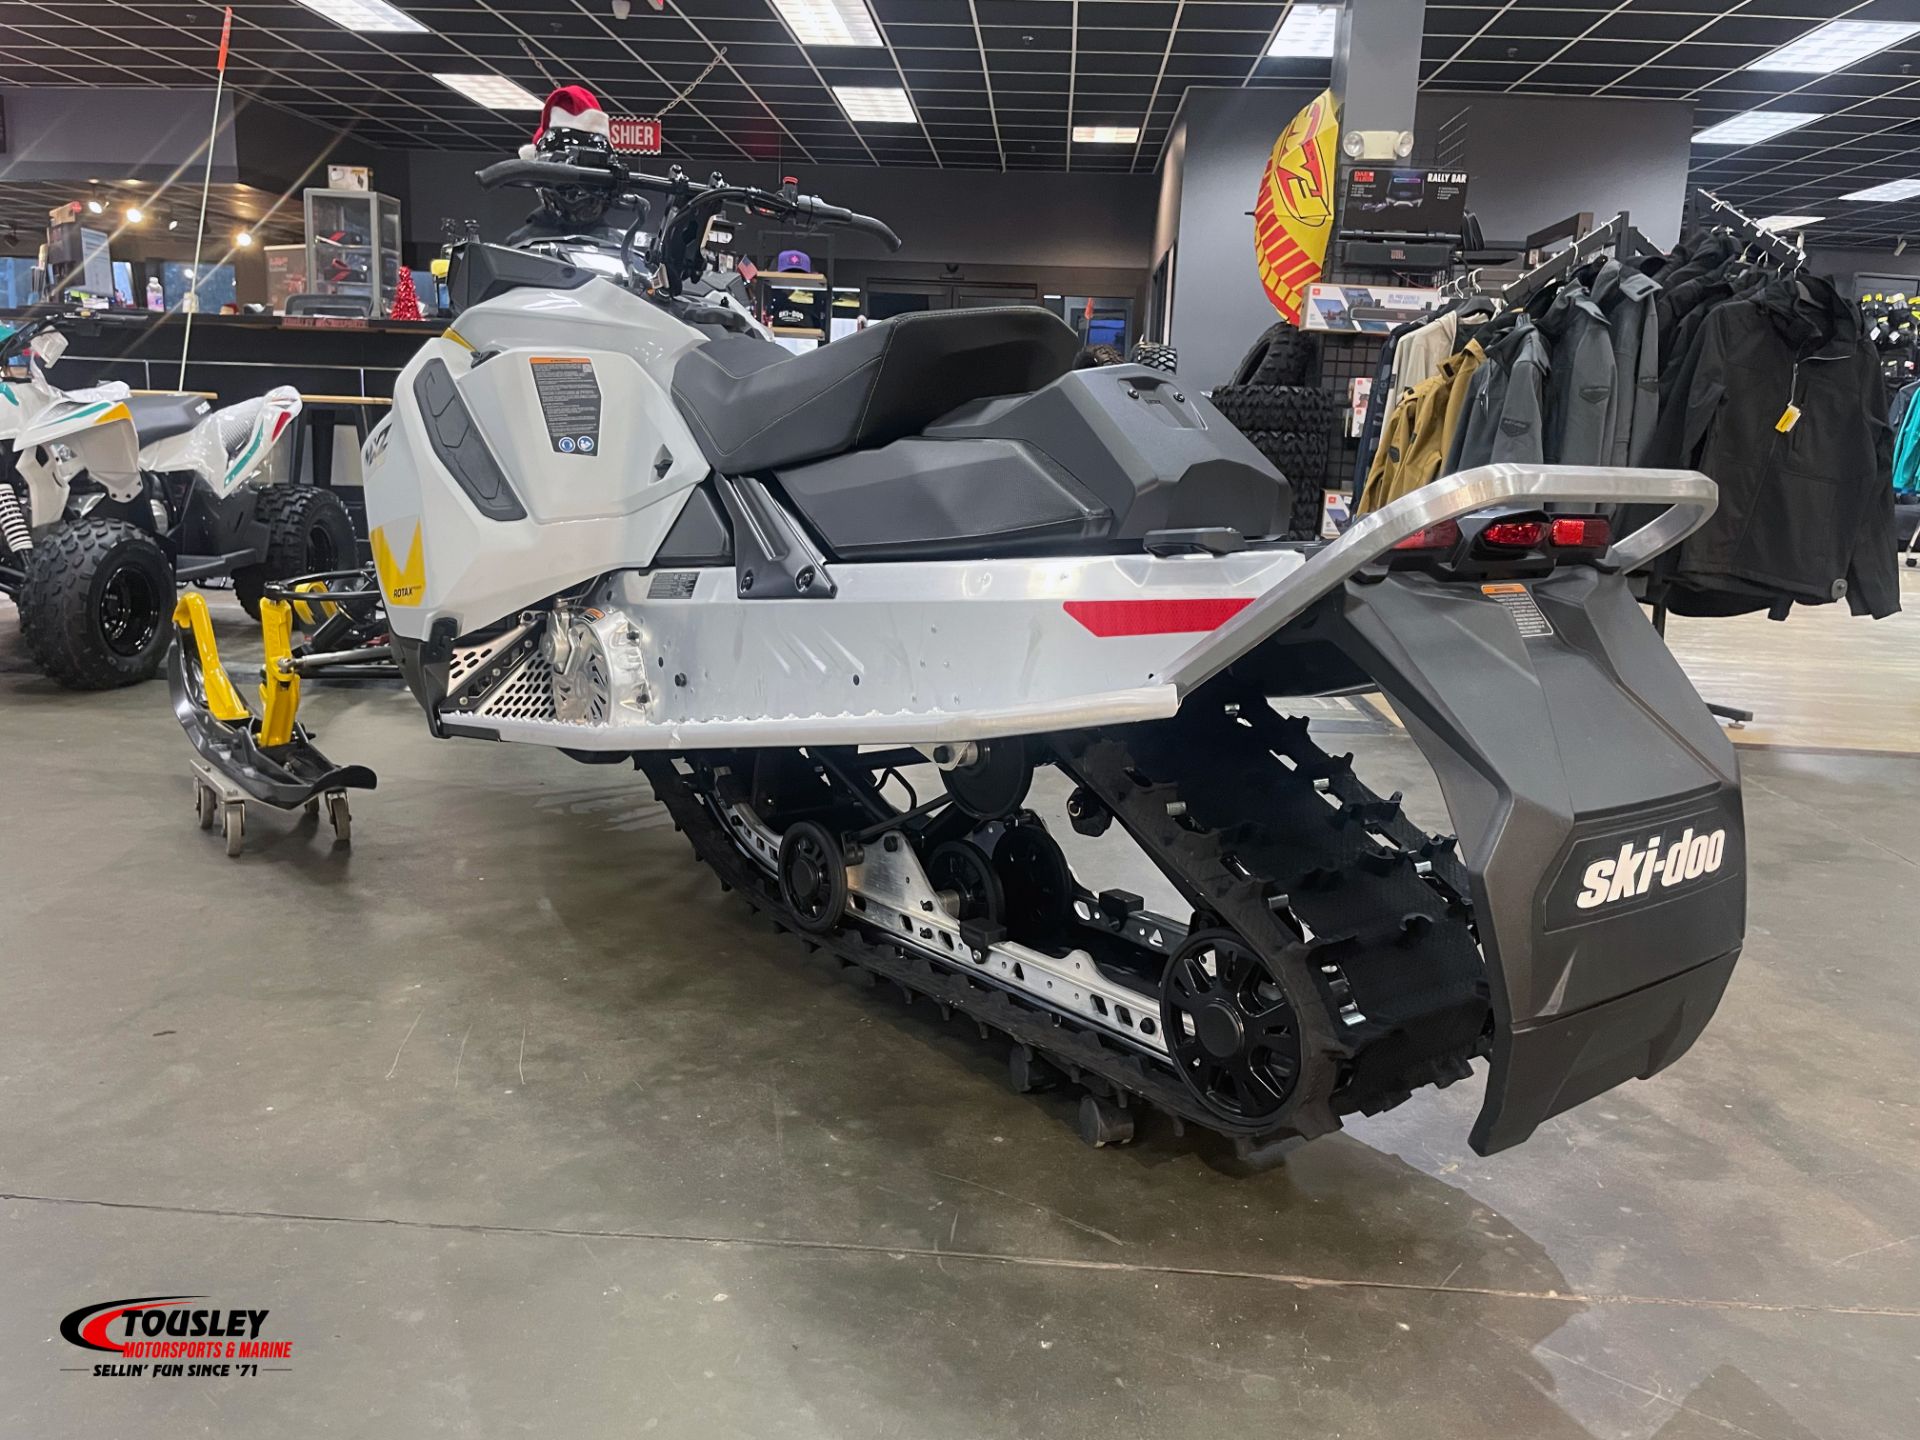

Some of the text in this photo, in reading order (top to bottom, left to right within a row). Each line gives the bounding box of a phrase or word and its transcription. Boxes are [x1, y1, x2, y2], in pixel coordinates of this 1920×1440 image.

[611, 124, 655, 146] SHIER
[1427, 173, 1467, 183] RALLY BAR
[393, 587, 413, 598] ROTAX
